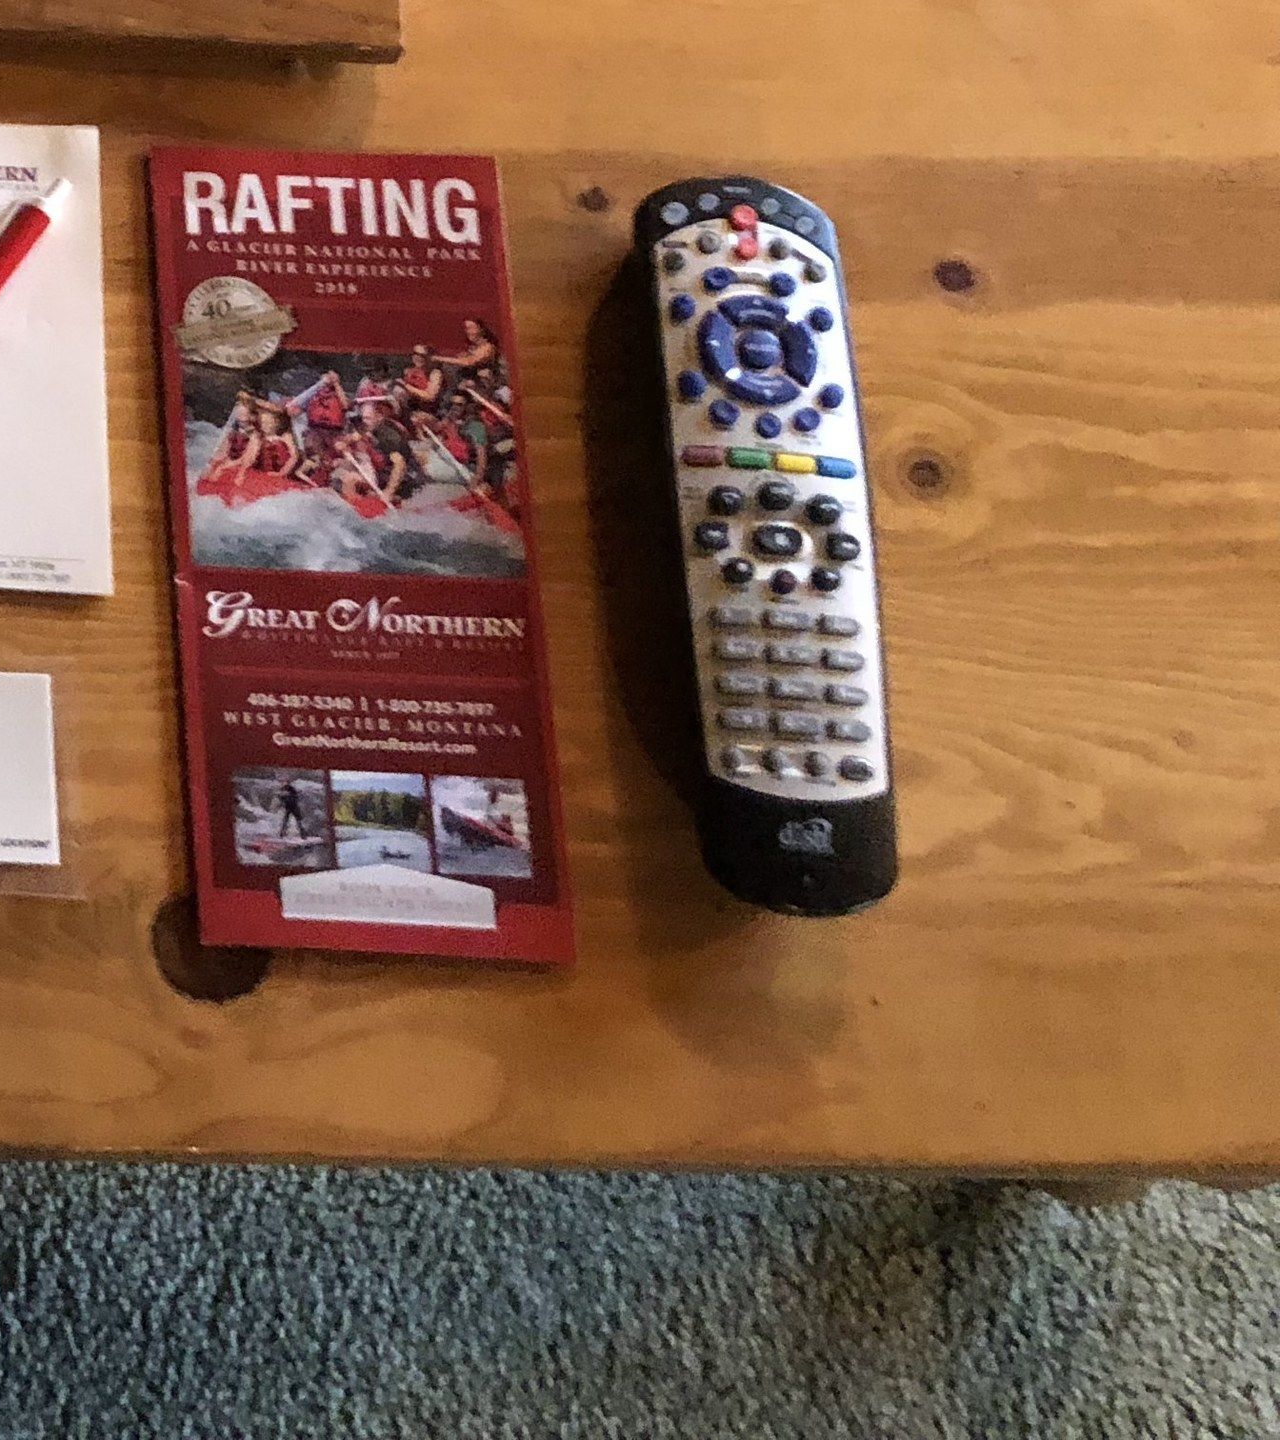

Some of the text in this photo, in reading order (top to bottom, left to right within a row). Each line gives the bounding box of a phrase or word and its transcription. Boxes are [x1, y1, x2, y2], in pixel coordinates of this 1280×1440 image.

[183, 171, 482, 246] RAFTING
[186, 240, 481, 261] A GLACIER NATIONAL PARK
[236, 259, 433, 278] RIVER EXPERIENCE
[201, 299, 231, 319] 40
[203, 590, 526, 638] GREAT NORTHERN
[223, 710, 281, 727] WEST
[407, 719, 524, 738] MONTANA
